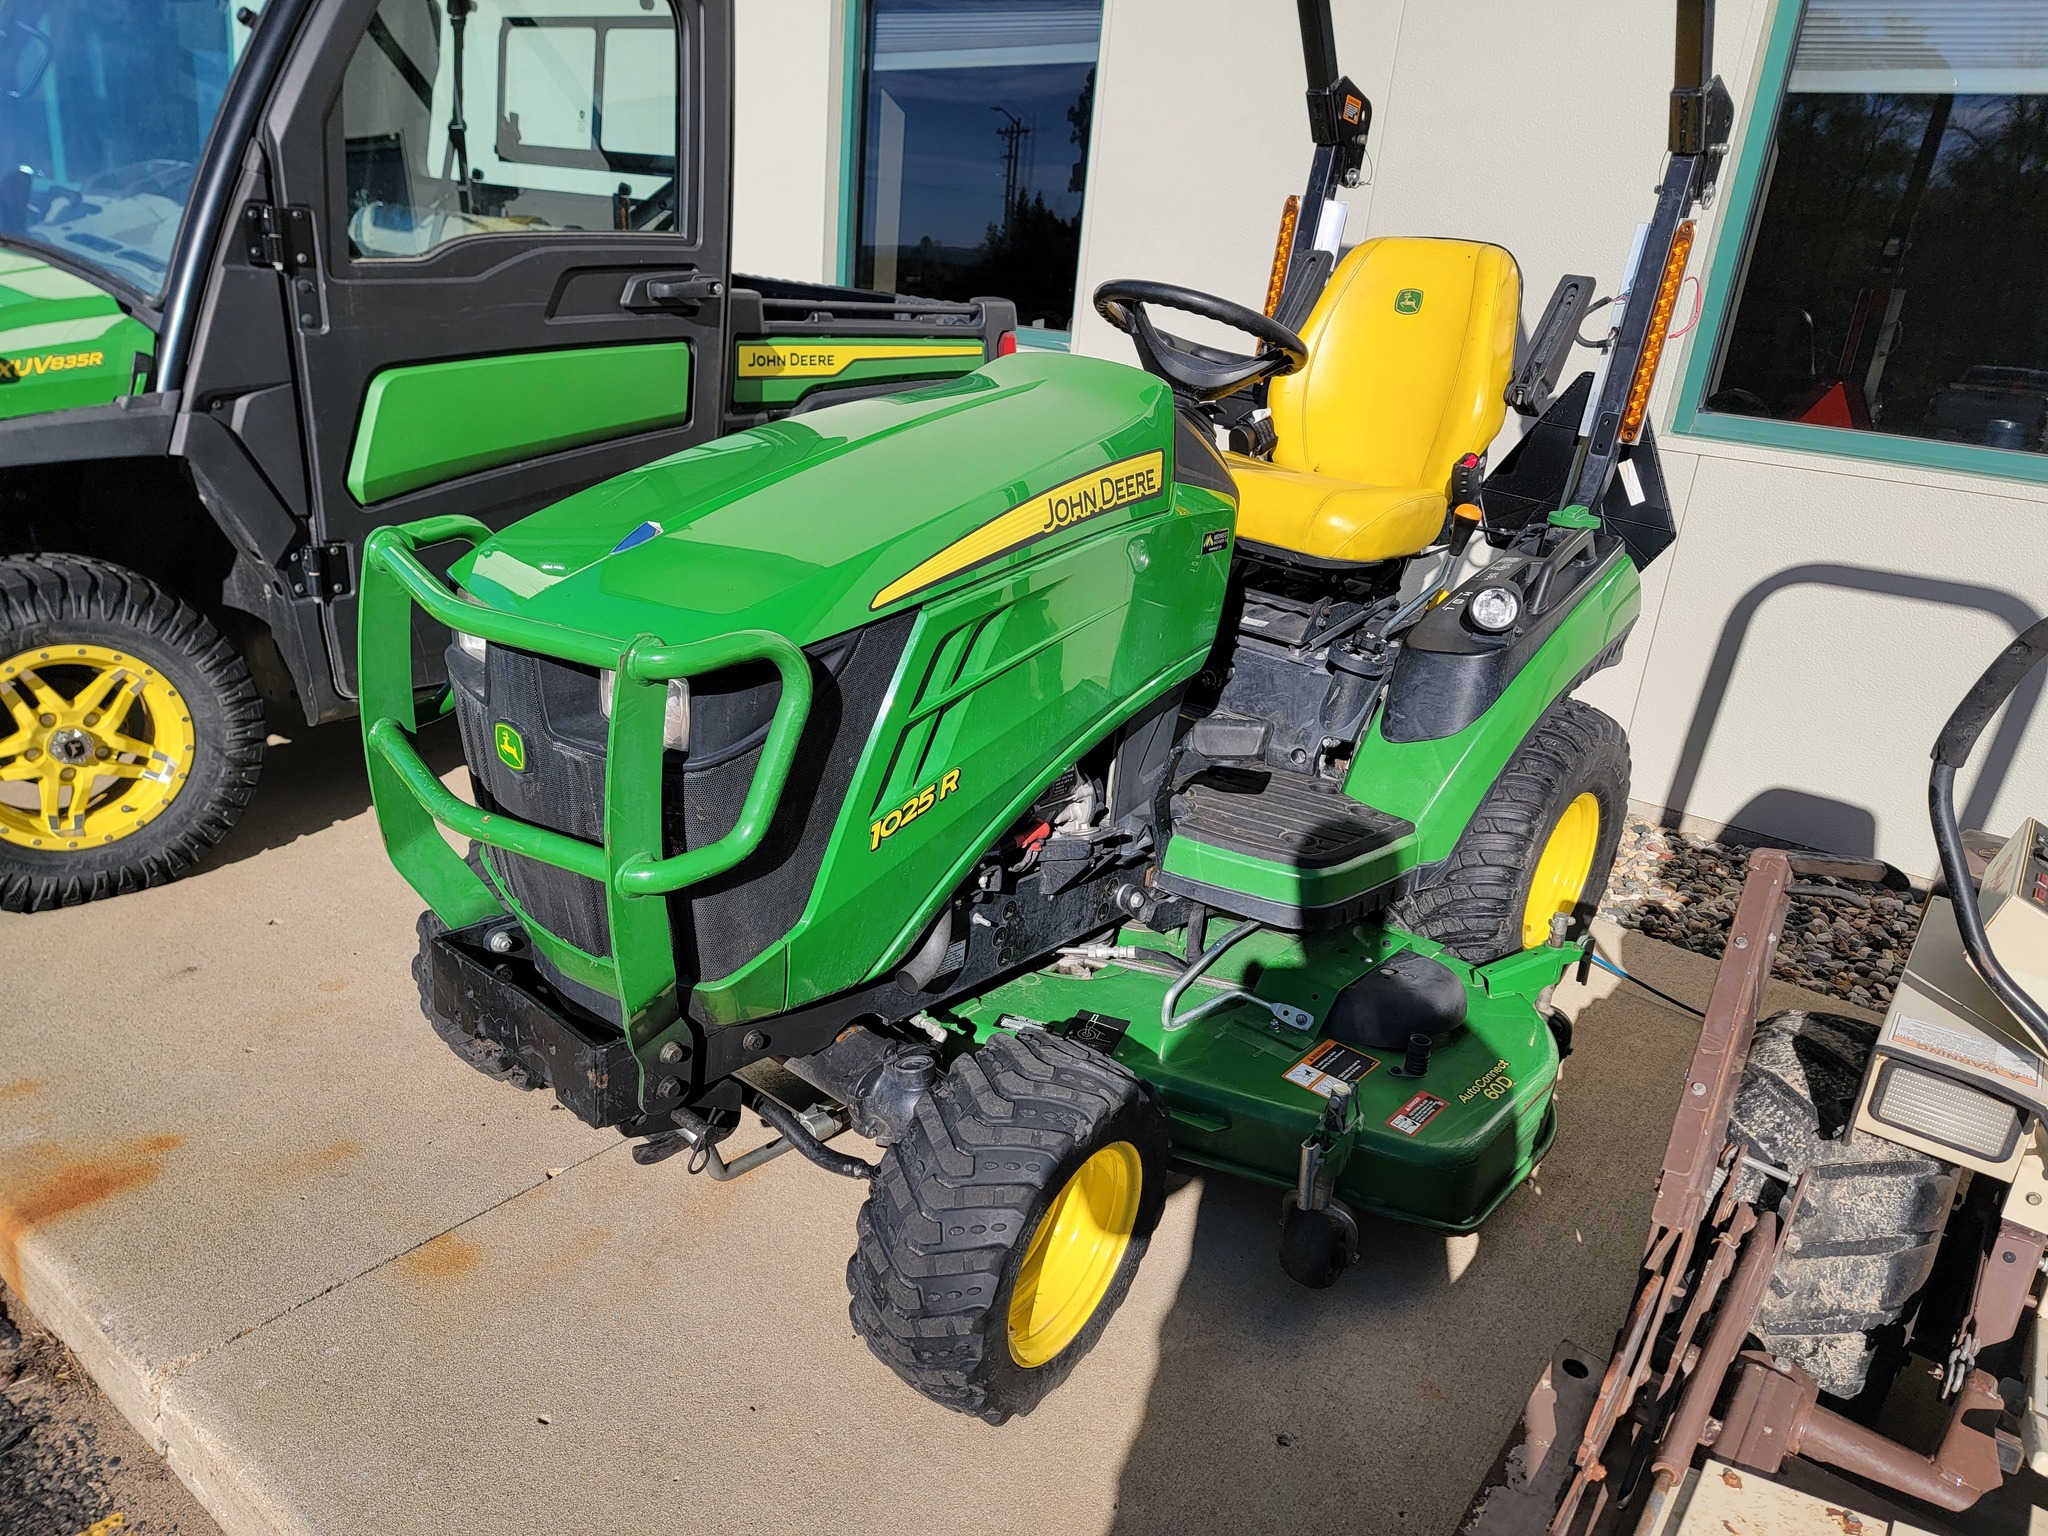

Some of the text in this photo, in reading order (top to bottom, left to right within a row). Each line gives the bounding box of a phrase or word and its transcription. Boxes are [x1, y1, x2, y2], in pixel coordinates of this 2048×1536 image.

[748, 352, 835, 367] JOHN DEERE
[1043, 468, 1157, 531] JOHN DEERE
[870, 767, 962, 853] 1025 R
[1917, 1043, 1999, 1075] WARNING
[1458, 1059, 1510, 1104] AutoConnect
[1483, 1075, 1513, 1100] 60D
